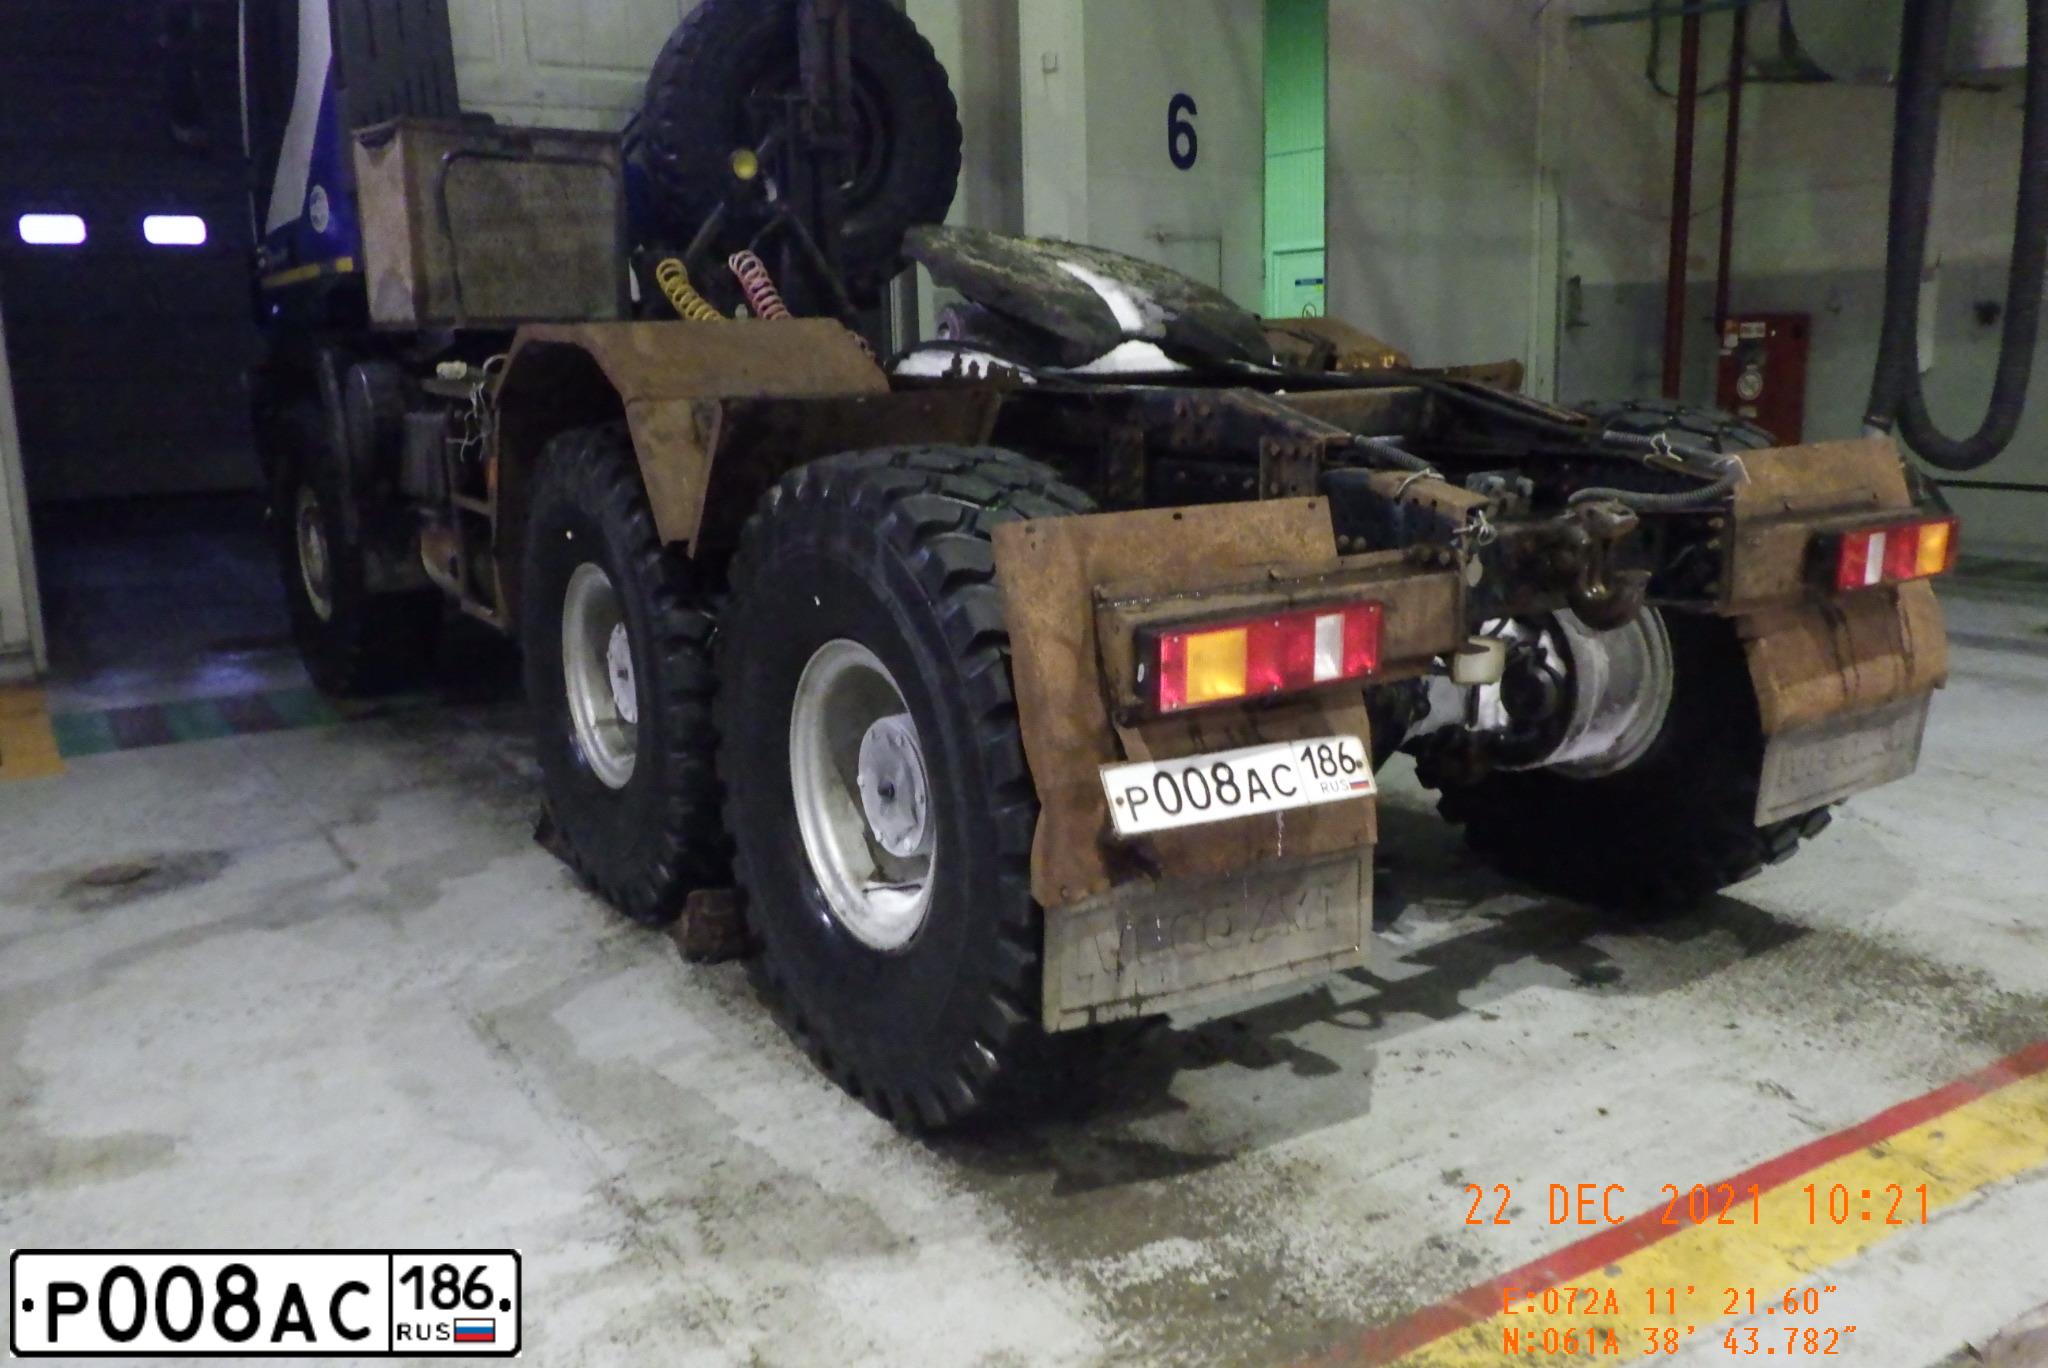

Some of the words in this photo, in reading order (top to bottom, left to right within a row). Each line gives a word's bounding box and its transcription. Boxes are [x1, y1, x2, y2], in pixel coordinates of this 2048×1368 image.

[1168, 92, 1198, 171] 6
[1125, 761, 1298, 822] P008AC
[1301, 742, 1357, 780] 186
[1320, 781, 1350, 794] RUS
